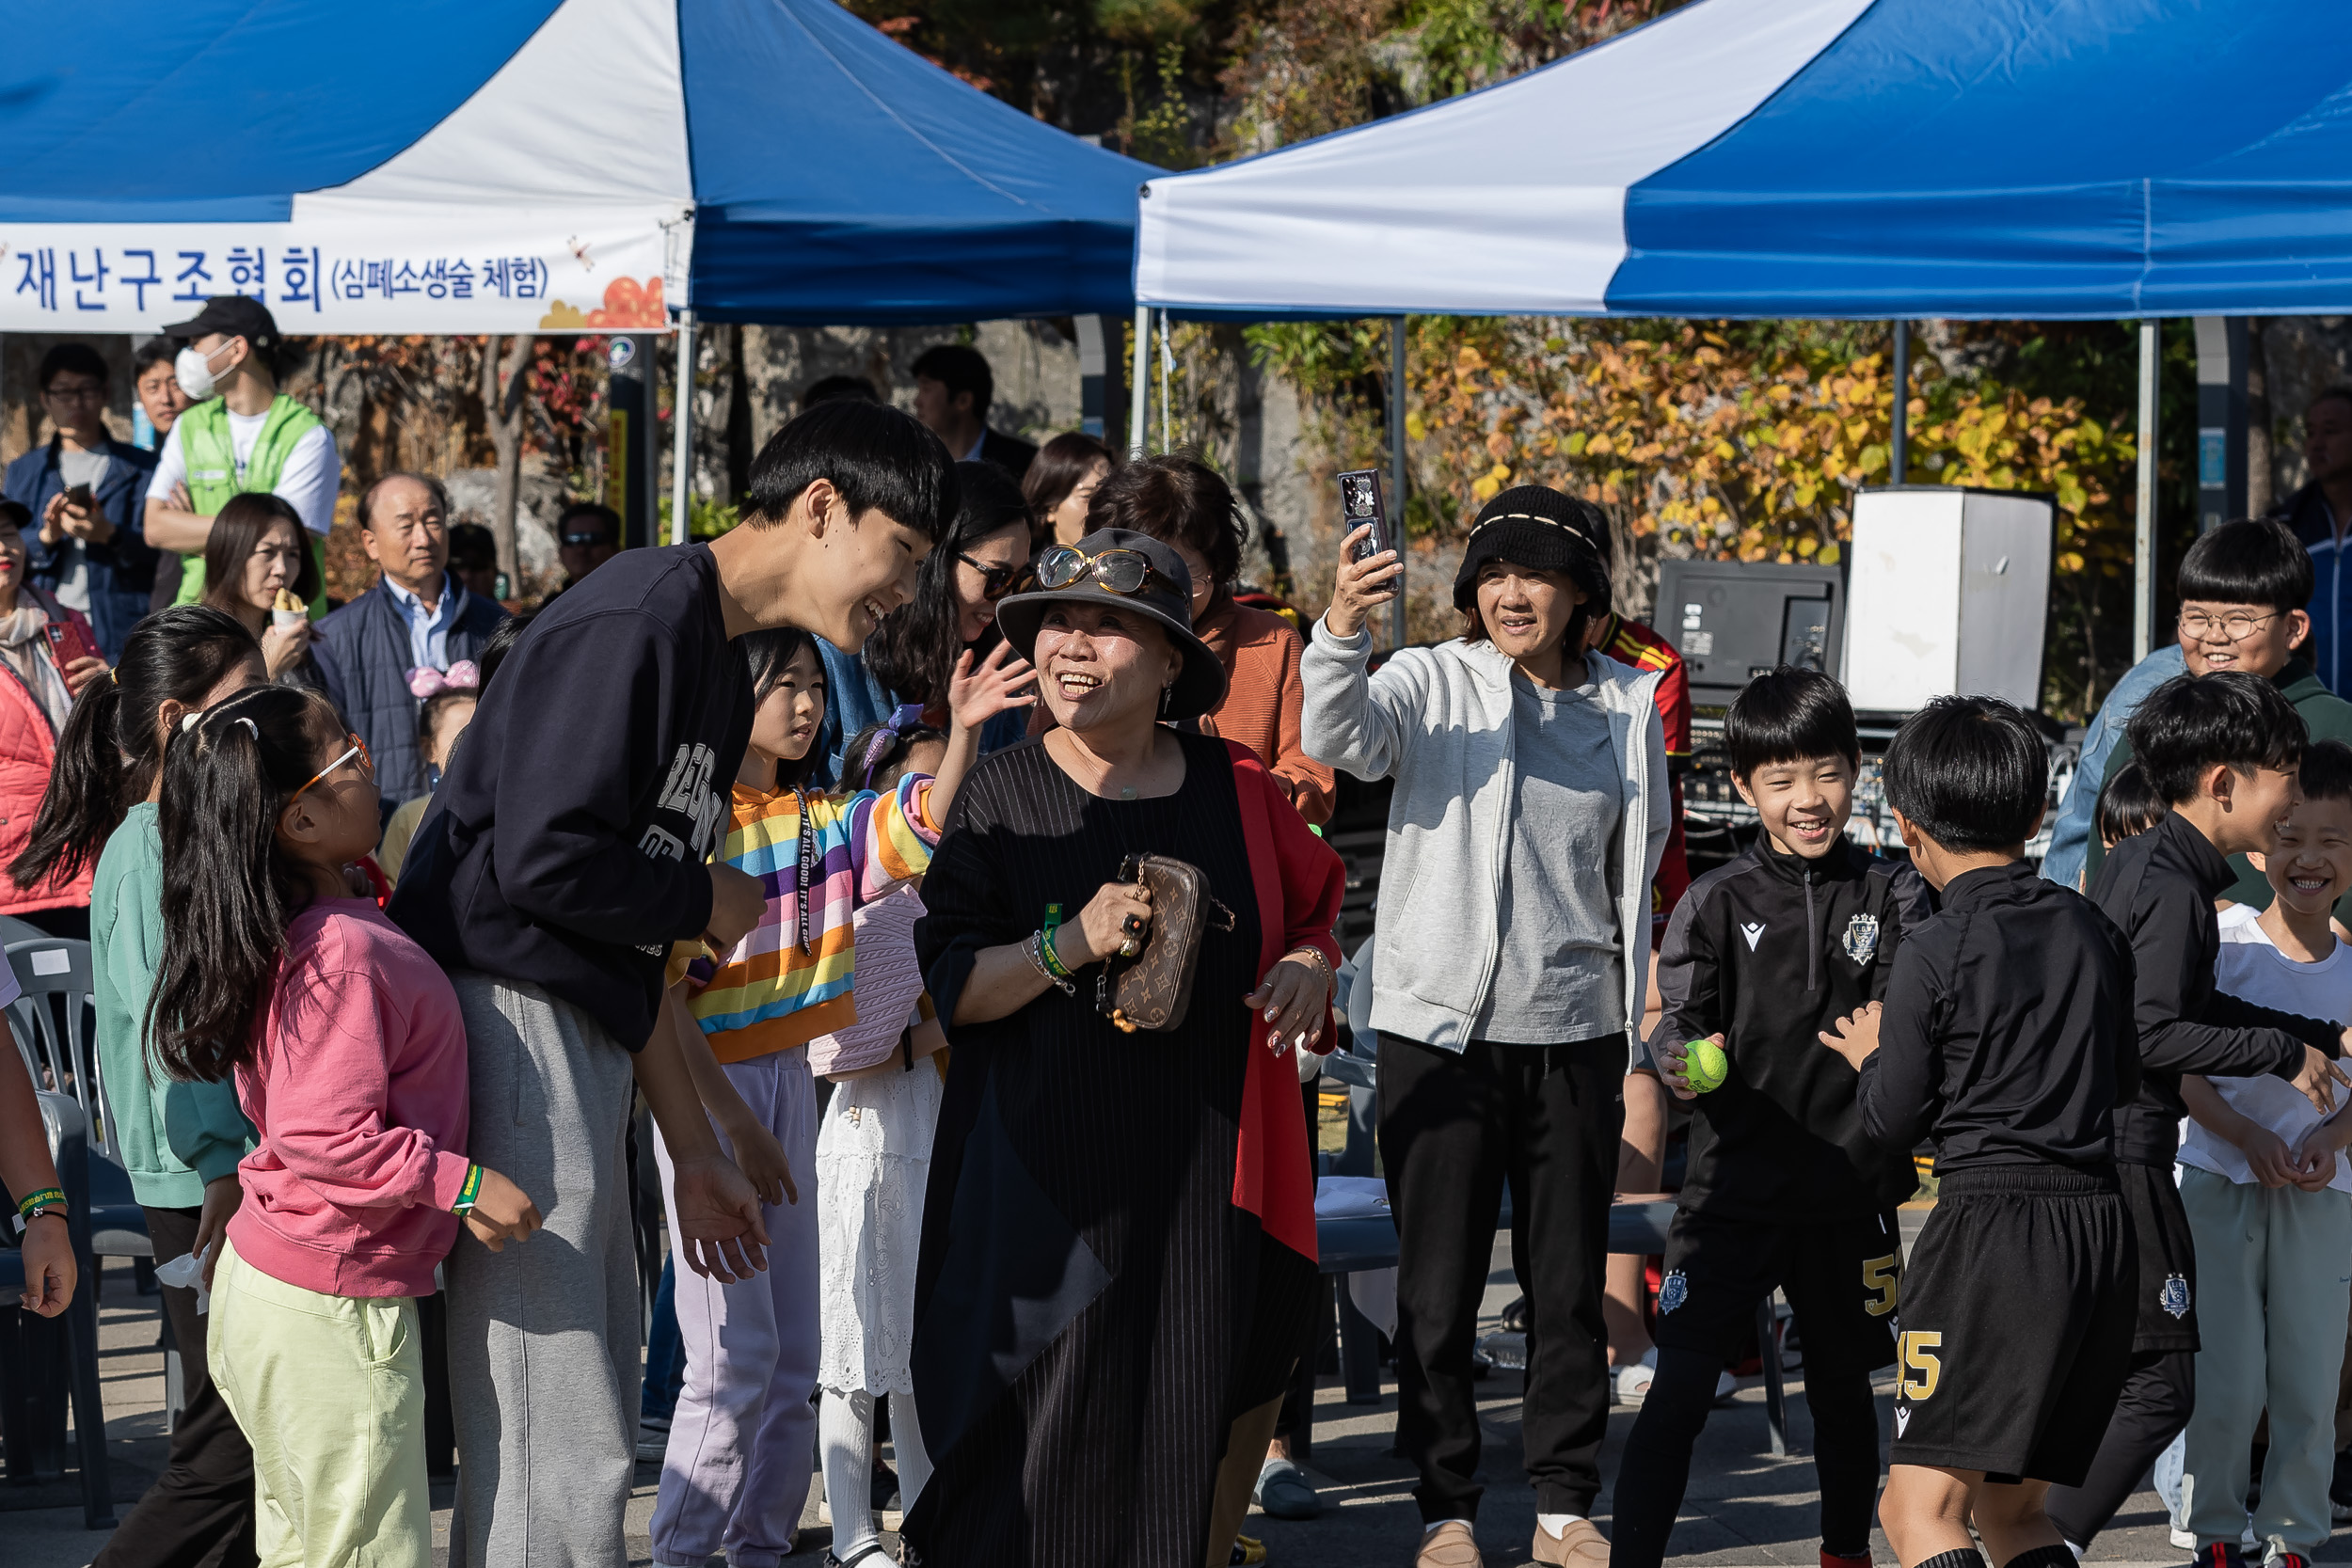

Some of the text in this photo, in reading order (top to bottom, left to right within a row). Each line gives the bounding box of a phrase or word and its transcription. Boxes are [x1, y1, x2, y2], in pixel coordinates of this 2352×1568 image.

[16, 246, 548, 312] 재난구조협회 (심폐소생술 체험)
[802, 837, 811, 854] ALL
[800, 856, 810, 887] GOOD!
